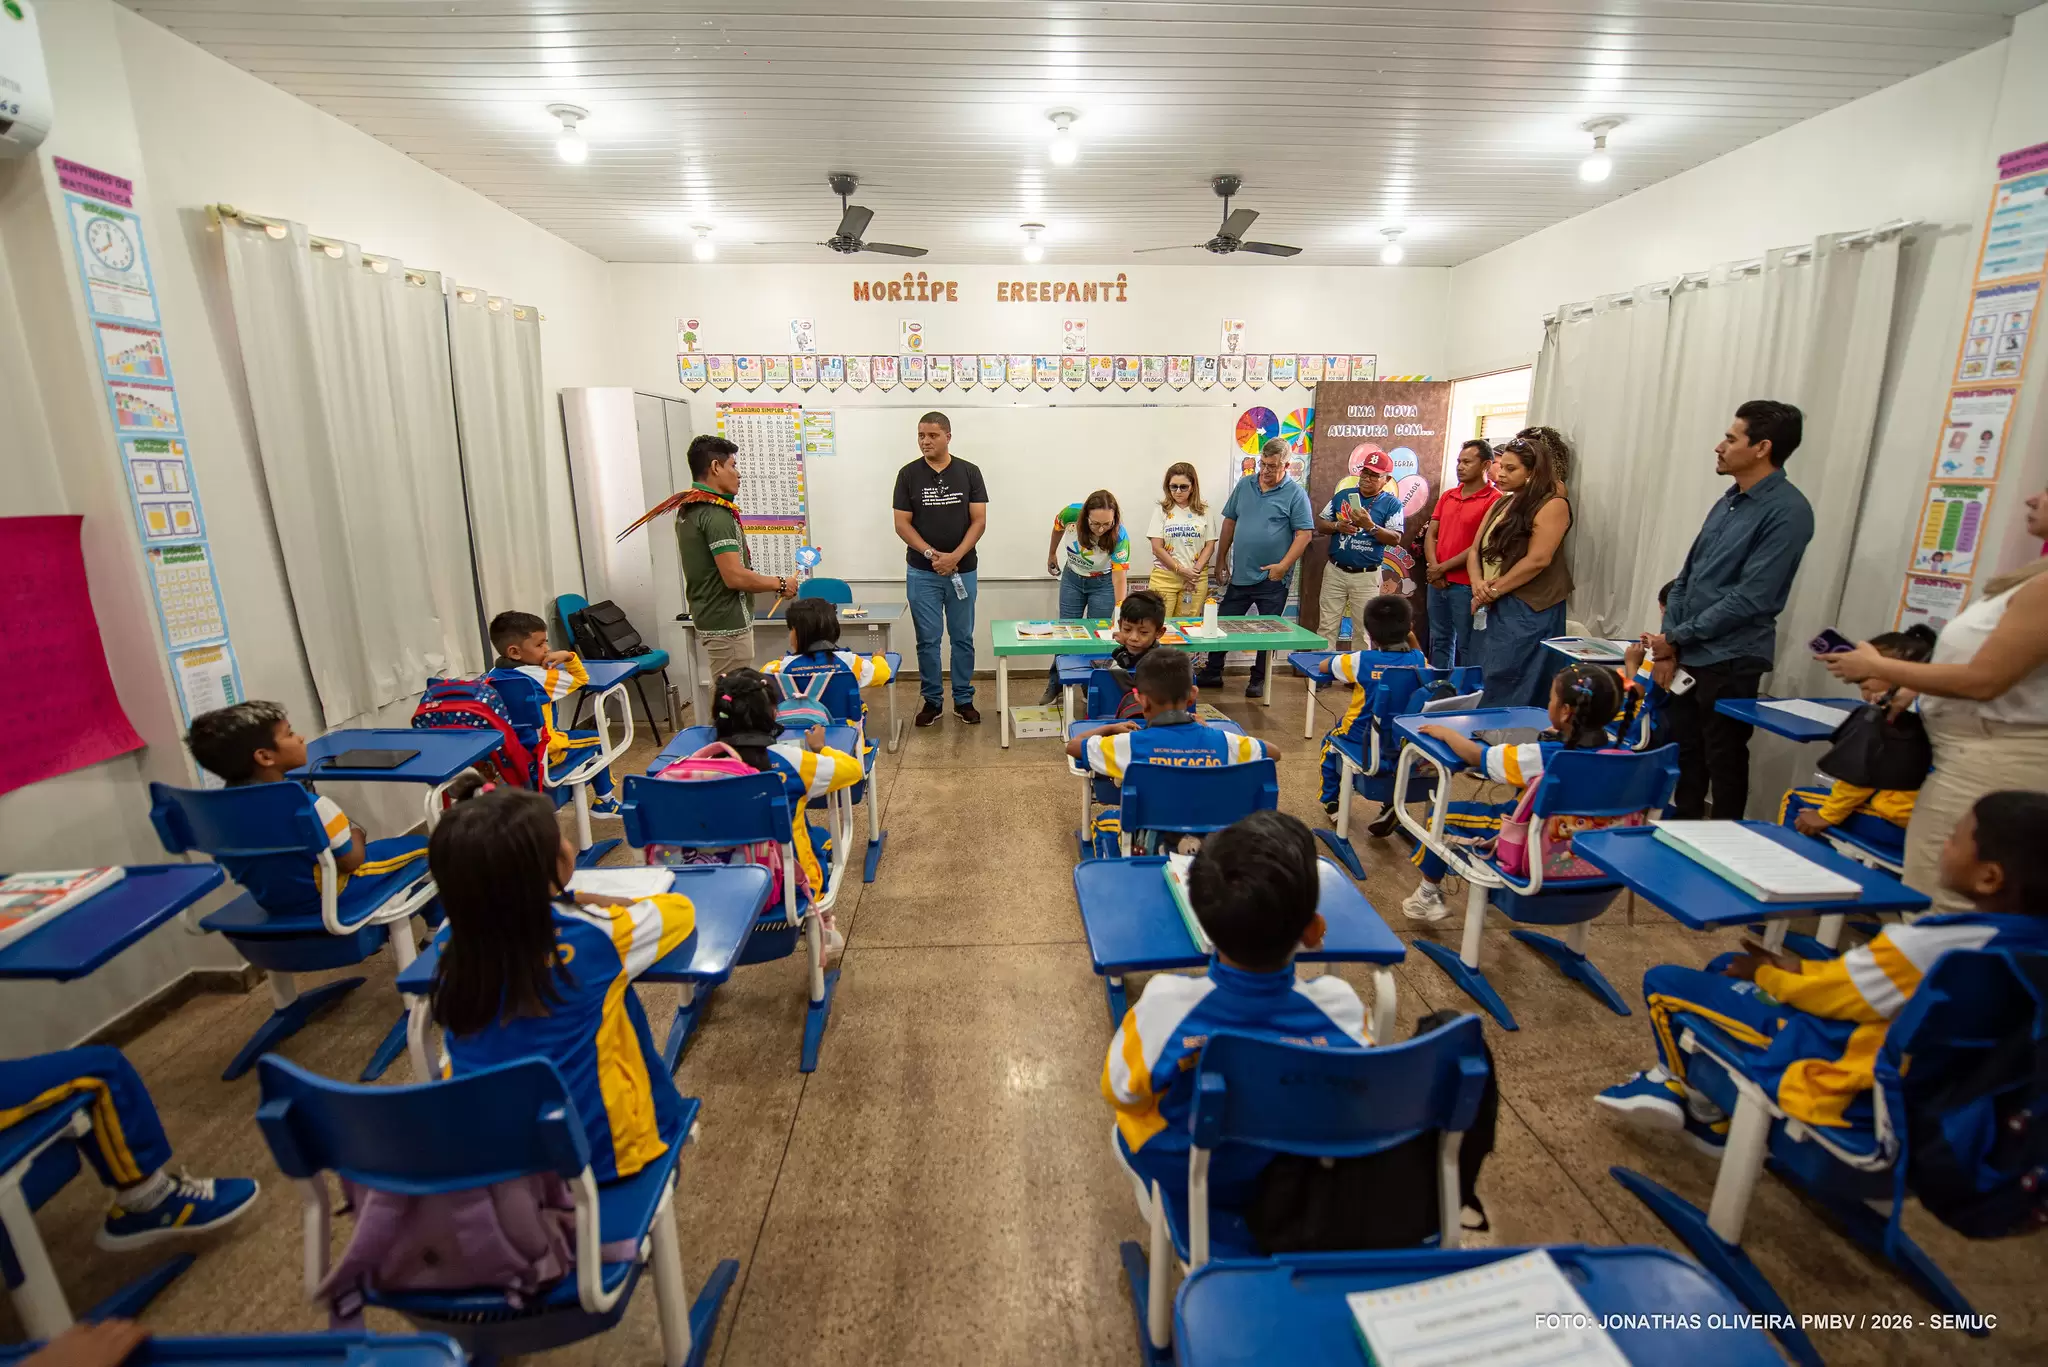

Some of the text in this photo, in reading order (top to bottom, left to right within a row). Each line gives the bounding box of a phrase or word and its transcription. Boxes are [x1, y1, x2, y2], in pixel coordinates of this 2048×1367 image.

[682, 358, 691, 369] A
[710, 358, 720, 369] B
[738, 358, 748, 369] C
[766, 358, 775, 369] D
[930, 358, 937, 369] J
[955, 357, 963, 369] K
[981, 358, 992, 369] L
[1063, 358, 1073, 370] O
[1090, 358, 1099, 369] P
[1117, 358, 1127, 370] Q
[1248, 357, 1257, 368] V
[1274, 358, 1285, 368] W
[1301, 357, 1309, 368] X
[1328, 357, 1337, 368] Y
[1354, 357, 1362, 369] Z
[1348, 405, 1417, 417] UMA NOVA
[1328, 424, 1434, 437] AVENTURA COM...
[1403, 482, 1420, 507] MIZADE
